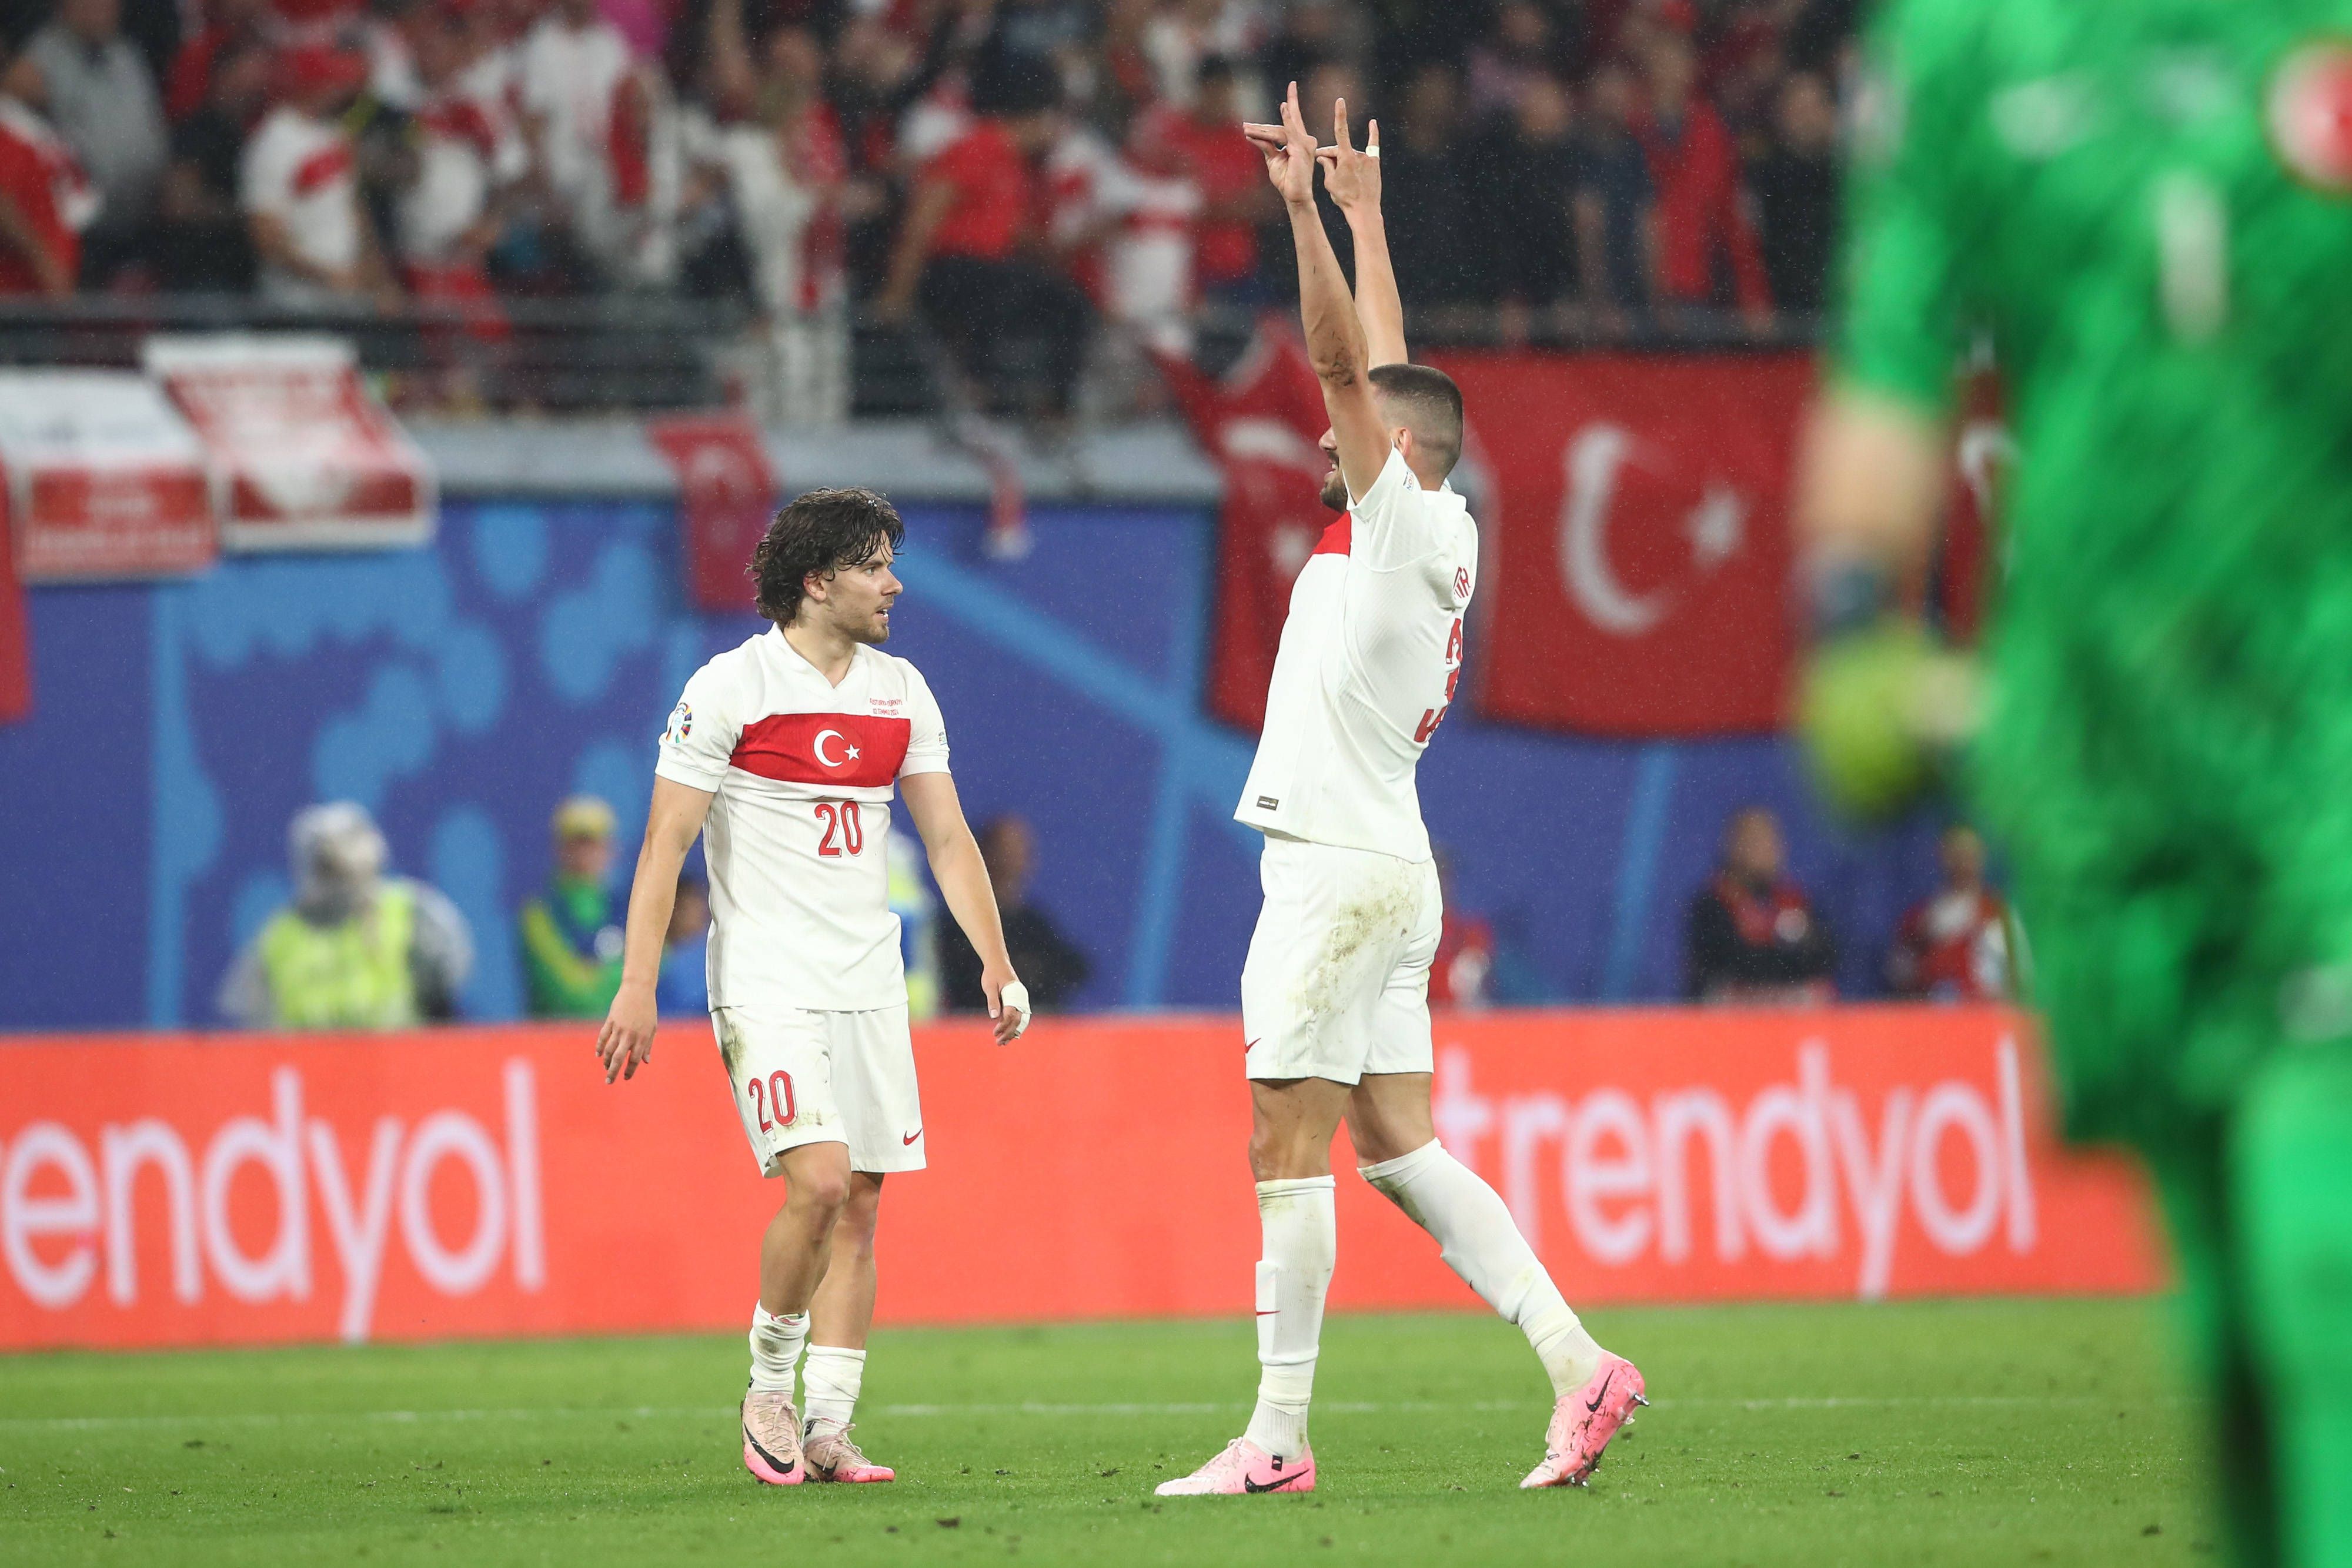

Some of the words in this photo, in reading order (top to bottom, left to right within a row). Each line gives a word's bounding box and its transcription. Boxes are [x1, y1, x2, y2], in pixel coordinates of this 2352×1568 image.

[814, 800, 864, 858] 20
[749, 1070, 798, 1135] 20
[1435, 1034, 2037, 1302] trendyol
[0, 1057, 546, 1345] endyol
